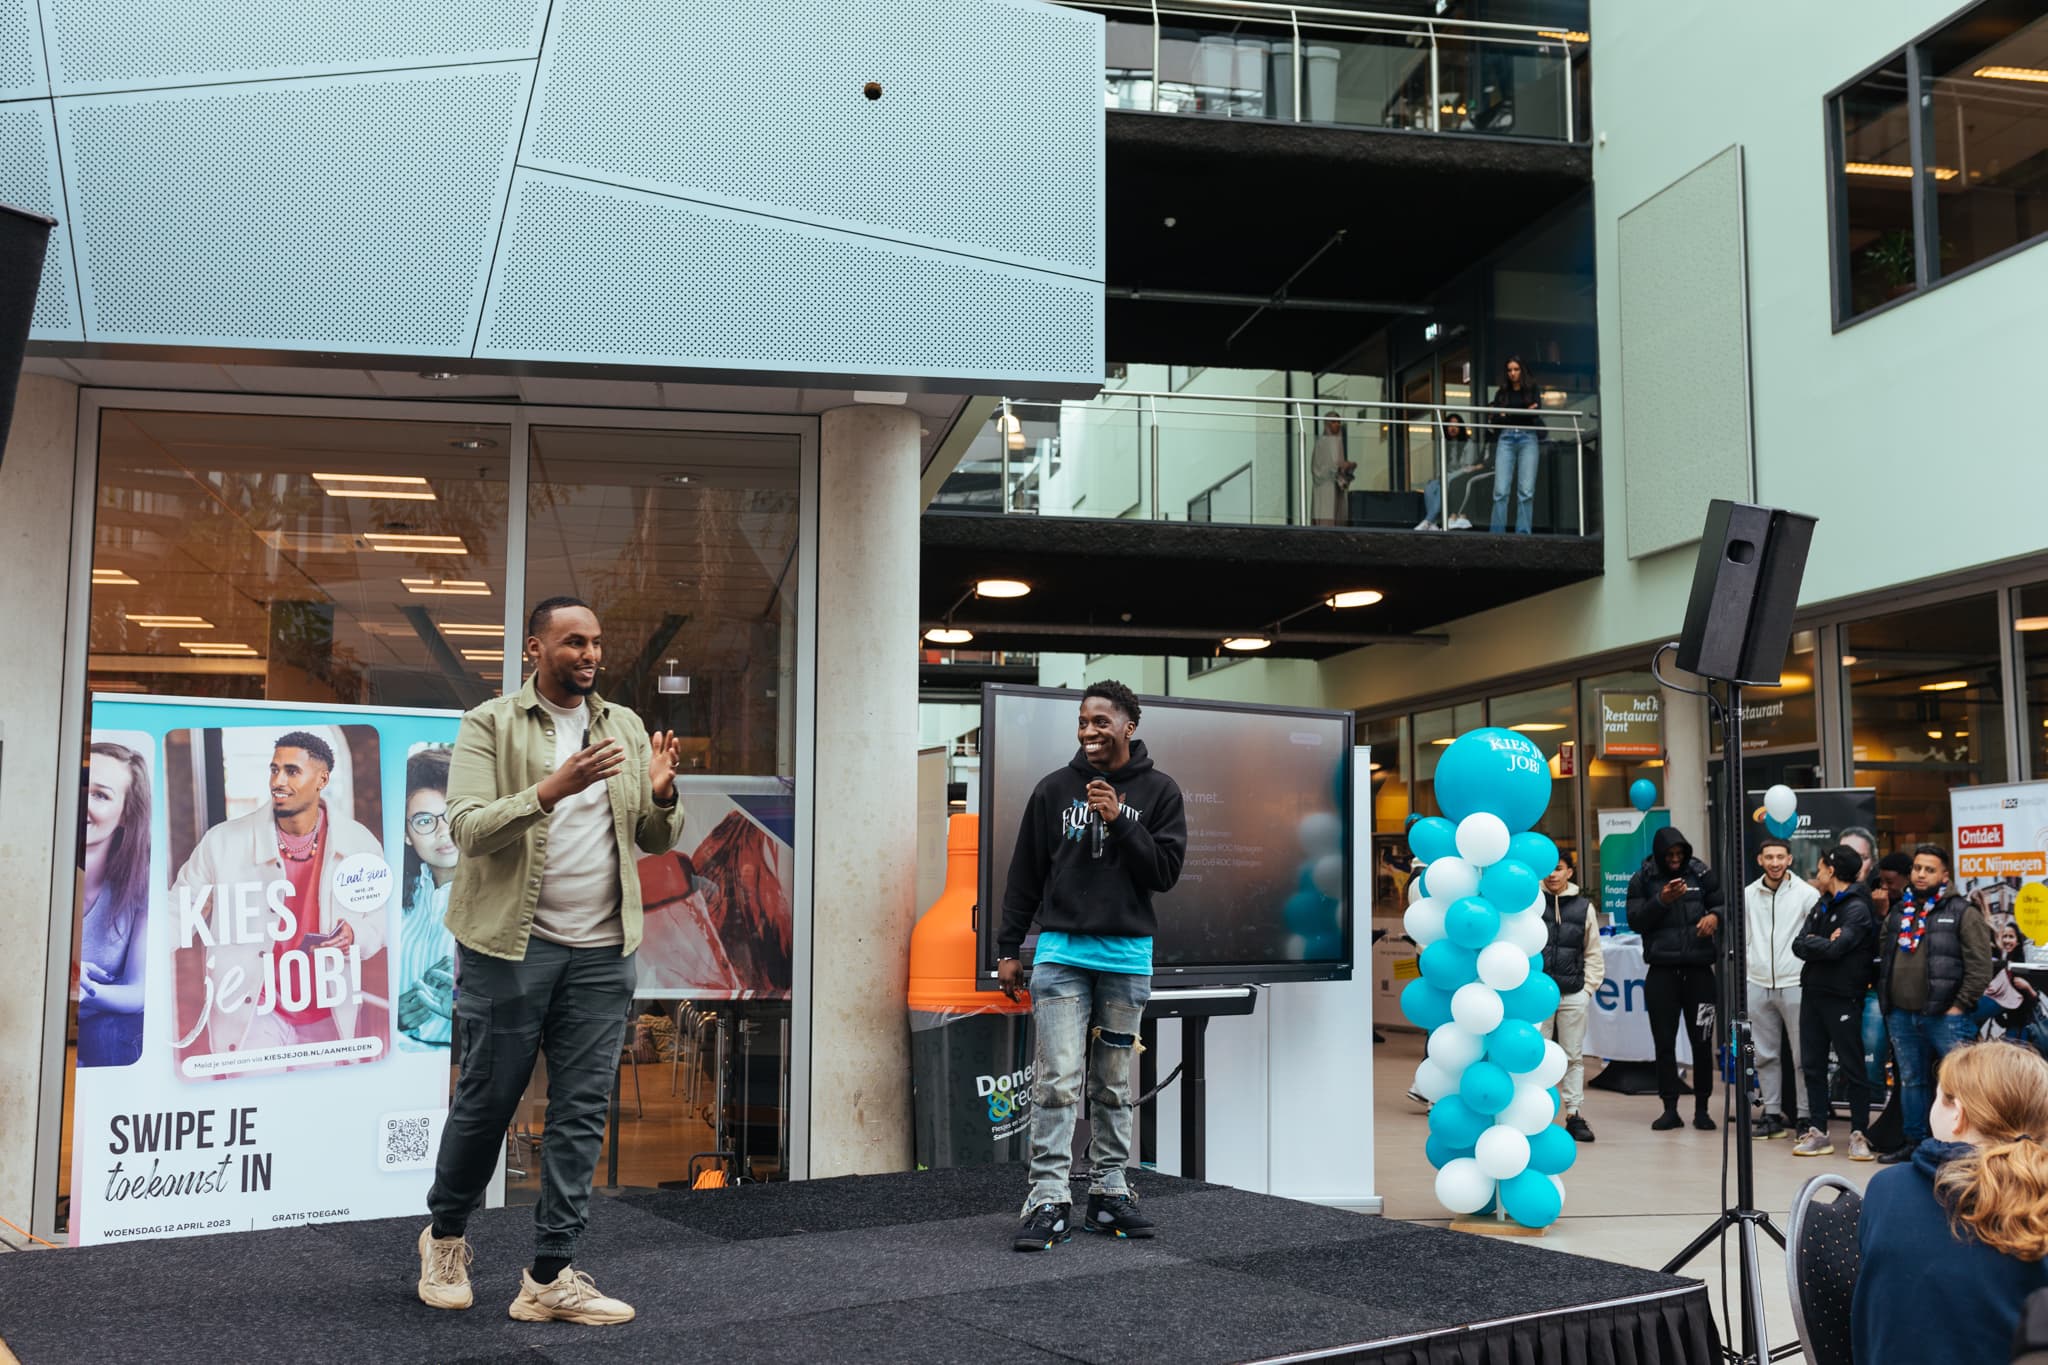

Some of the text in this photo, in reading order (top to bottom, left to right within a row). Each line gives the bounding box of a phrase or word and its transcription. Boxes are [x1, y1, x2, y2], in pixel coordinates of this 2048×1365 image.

[1490, 738, 1530, 752] KIES
[1507, 754, 1540, 775] JOB!
[1961, 827, 2000, 845] Ontdek
[337, 867, 387, 887] Laat zien
[1962, 856, 2042, 877] ROC Nijmegen
[179, 880, 298, 949] KIES
[168, 944, 364, 1048] je JOB!
[194, 1060, 212, 1070] Meld
[264, 1043, 373, 1062] KIESJEJOB.NL/AANMELDEN
[109, 1107, 258, 1155] SWIPE JE
[105, 1153, 272, 1202] toekomst IN
[272, 1208, 350, 1222] GRATIS TOEGANG
[104, 1219, 231, 1238] WOENSDAG 12 APRIL 2023
